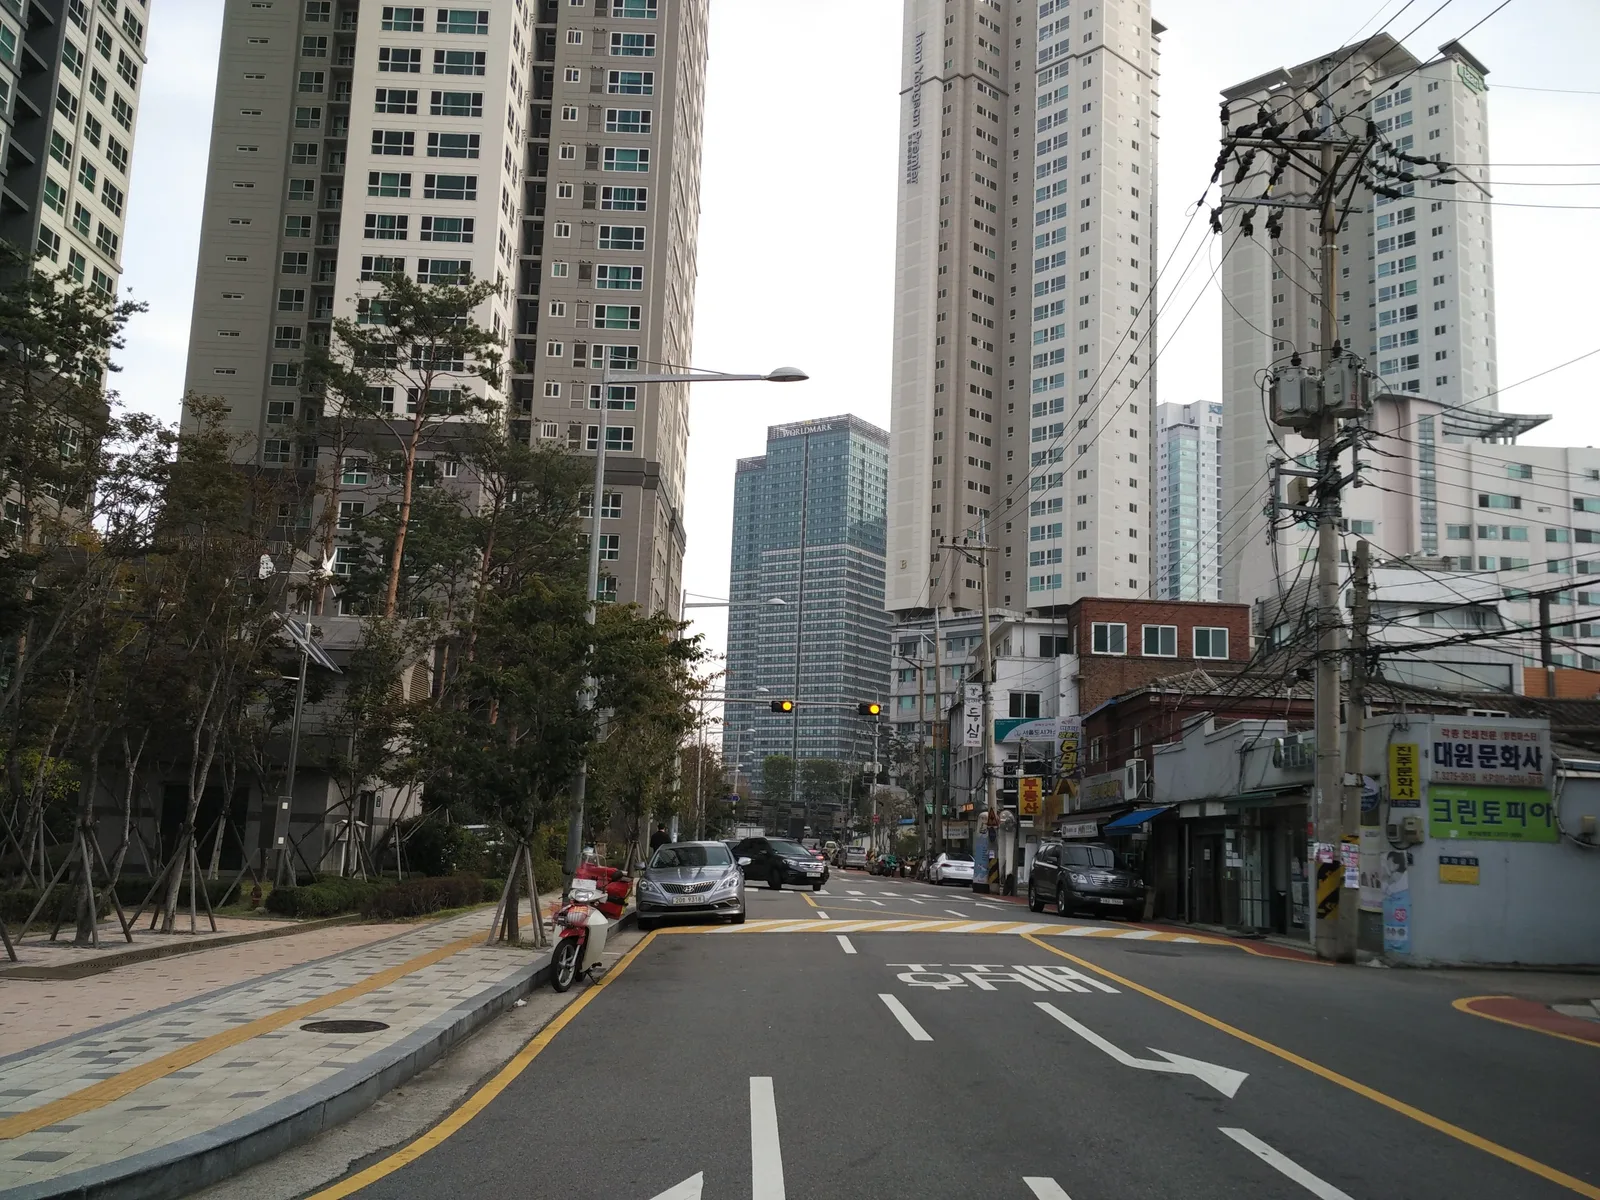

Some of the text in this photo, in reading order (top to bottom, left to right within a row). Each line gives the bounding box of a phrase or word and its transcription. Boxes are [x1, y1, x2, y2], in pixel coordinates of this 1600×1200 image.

[911, 129, 923, 184] Premier
[782, 423, 833, 438] WORLDMARK
[966, 707, 981, 739] 등심
[1396, 746, 1416, 798] 진주문화사
[1433, 741, 1543, 772] 대원문화사
[1023, 778, 1039, 814] 부동산
[1432, 798, 1553, 828] 크린토피아
